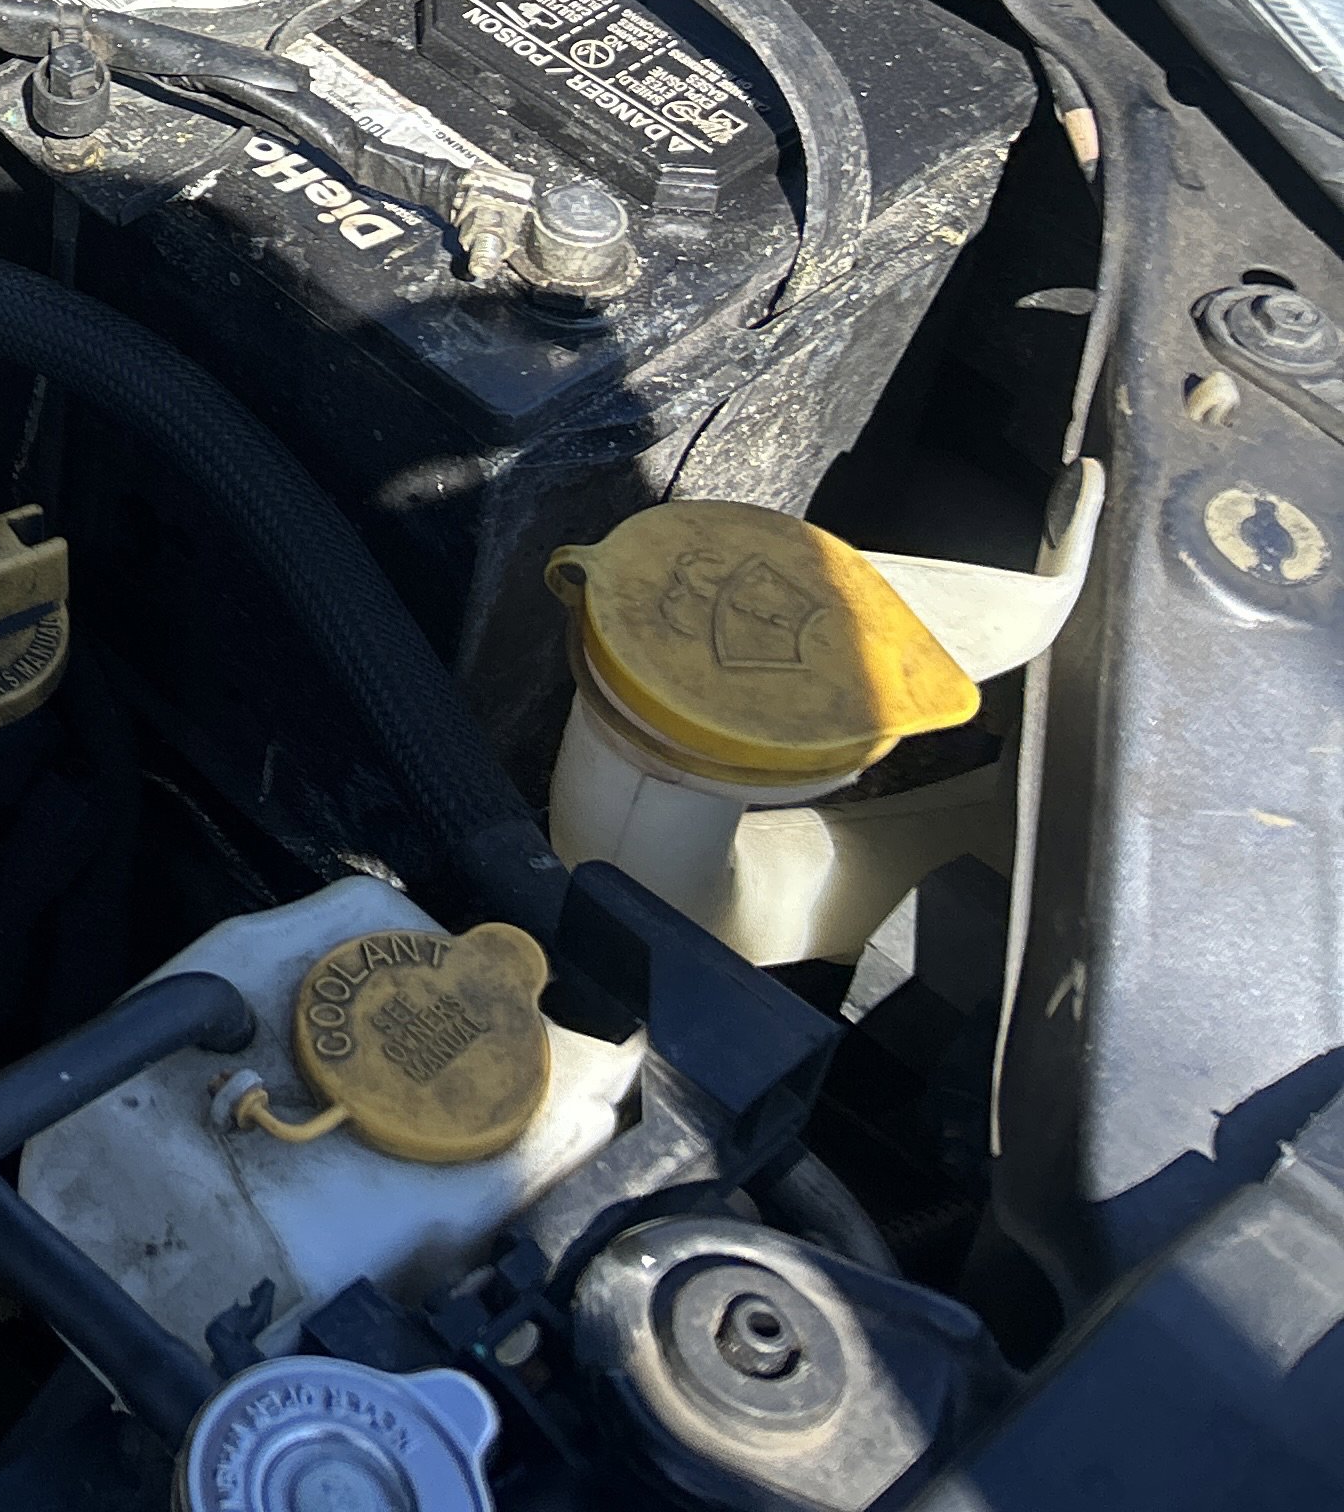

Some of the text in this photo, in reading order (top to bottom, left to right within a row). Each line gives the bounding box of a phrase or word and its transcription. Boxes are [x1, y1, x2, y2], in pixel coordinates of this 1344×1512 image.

[567, 0, 593, 17] CAN
[460, 5, 554, 67] POISON
[601, 33, 629, 52] NO
[564, 72, 670, 141] DANGER
[617, 73, 666, 106] SHIELD
[640, 74, 678, 99] EYES
[647, 64, 718, 110] EXPLOSIVE
[684, 72, 729, 102] GASES
[16, 616, 62, 680] MANUAL
[309, 935, 451, 1057] COOLANT
[372, 992, 417, 1034] SEE
[384, 993, 463, 1063] OWNERS
[404, 1013, 491, 1085] MANUAL
